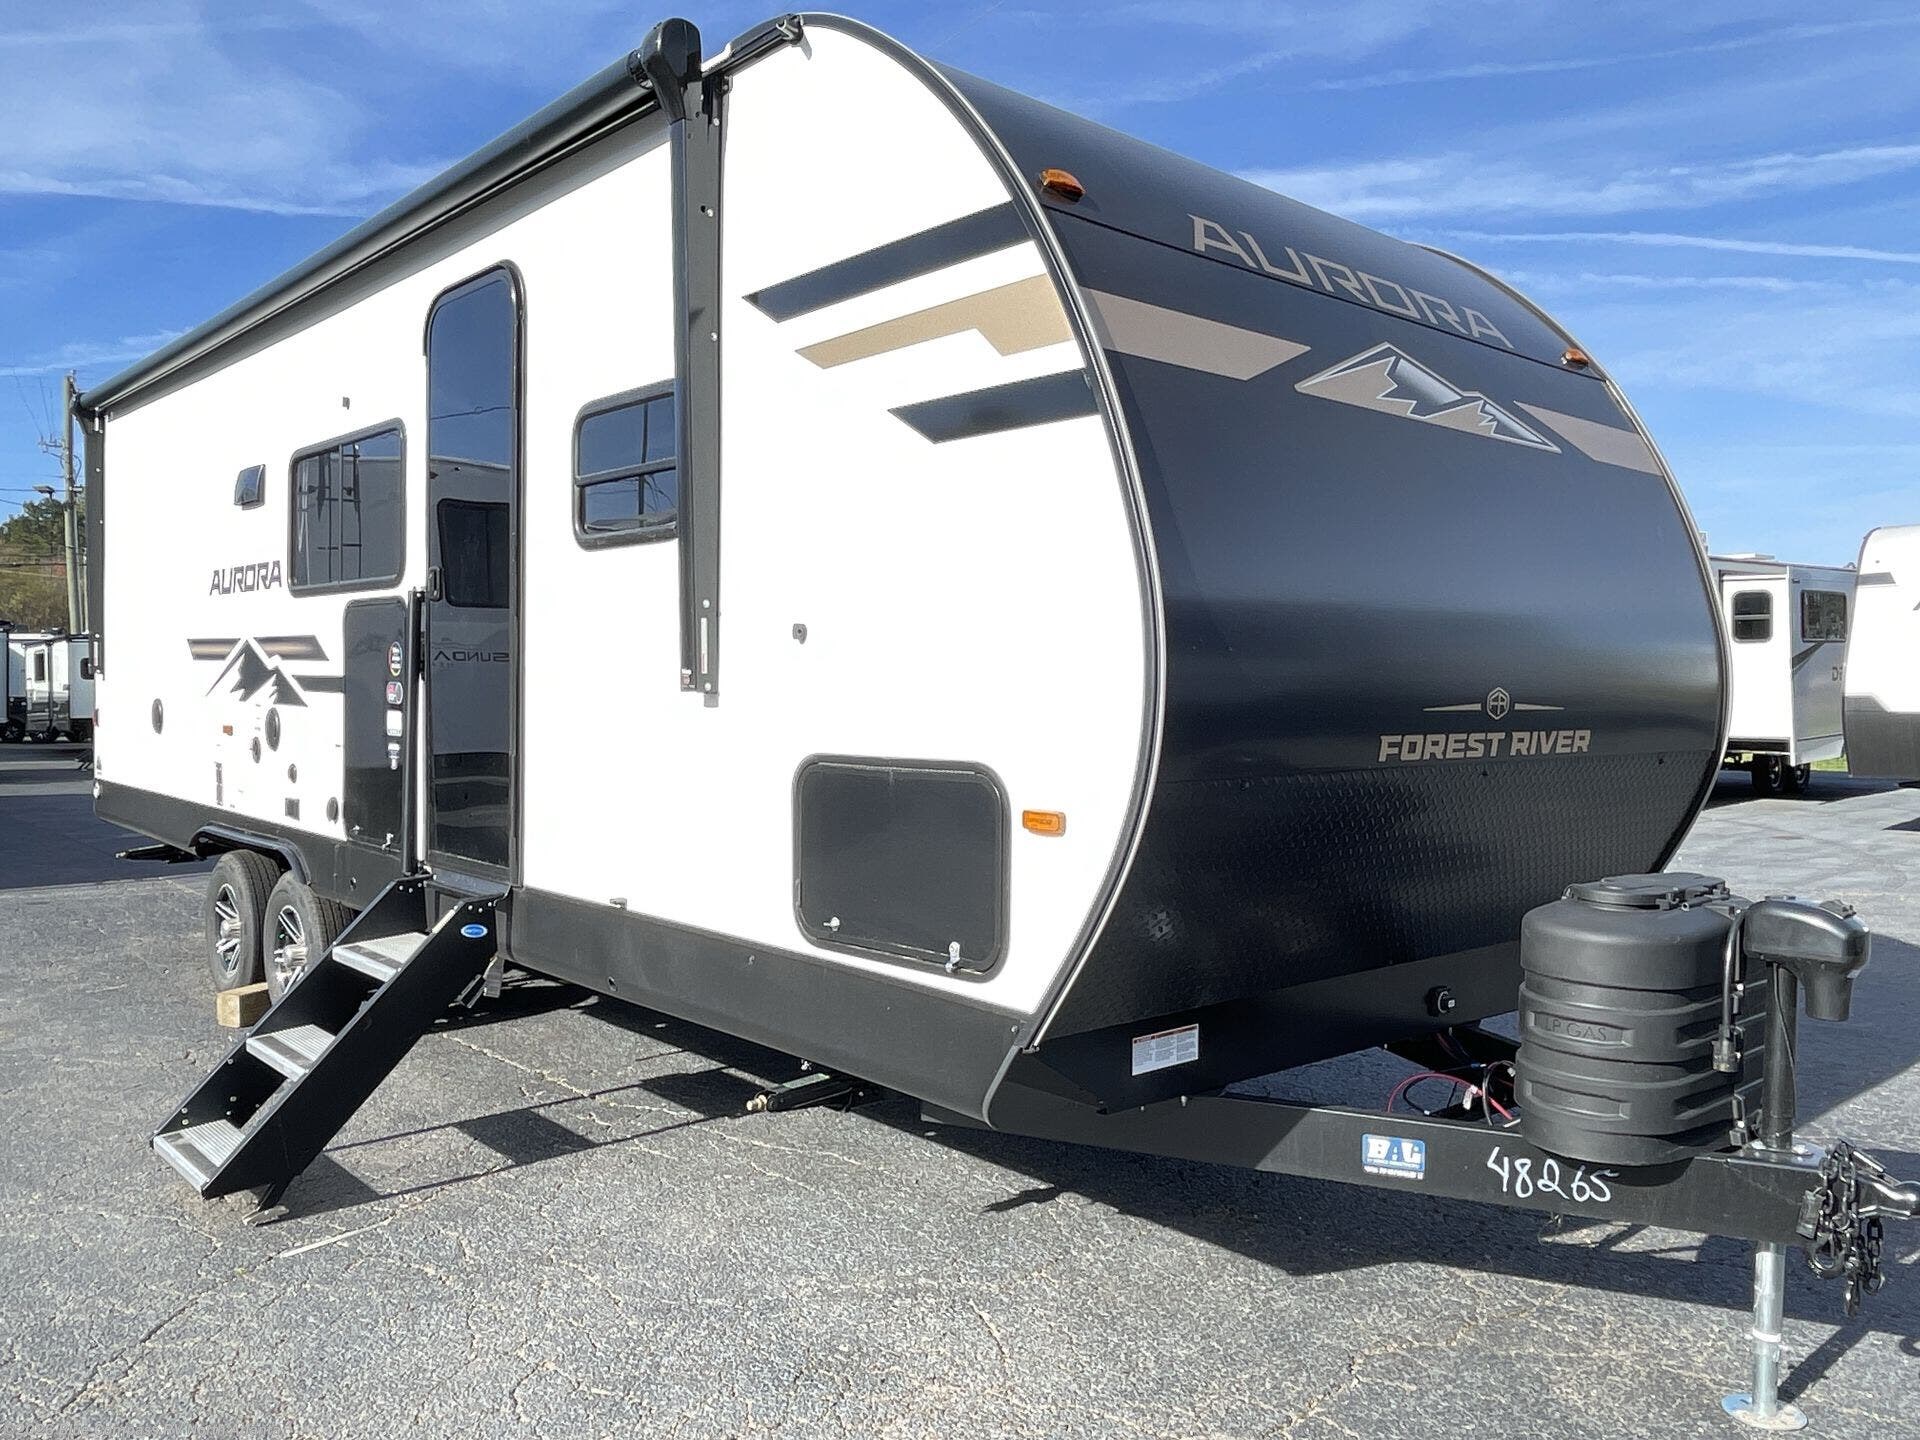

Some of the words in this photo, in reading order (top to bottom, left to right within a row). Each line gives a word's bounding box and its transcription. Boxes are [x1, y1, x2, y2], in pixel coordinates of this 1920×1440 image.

[1187, 213, 1514, 349] AURORA
[209, 560, 282, 596] AURORA
[1378, 731, 1506, 763] FOREST
[1509, 730, 1592, 757] RIVER
[1567, 1022, 1607, 1041] GAS
[1486, 1146, 1620, 1203] 48265
